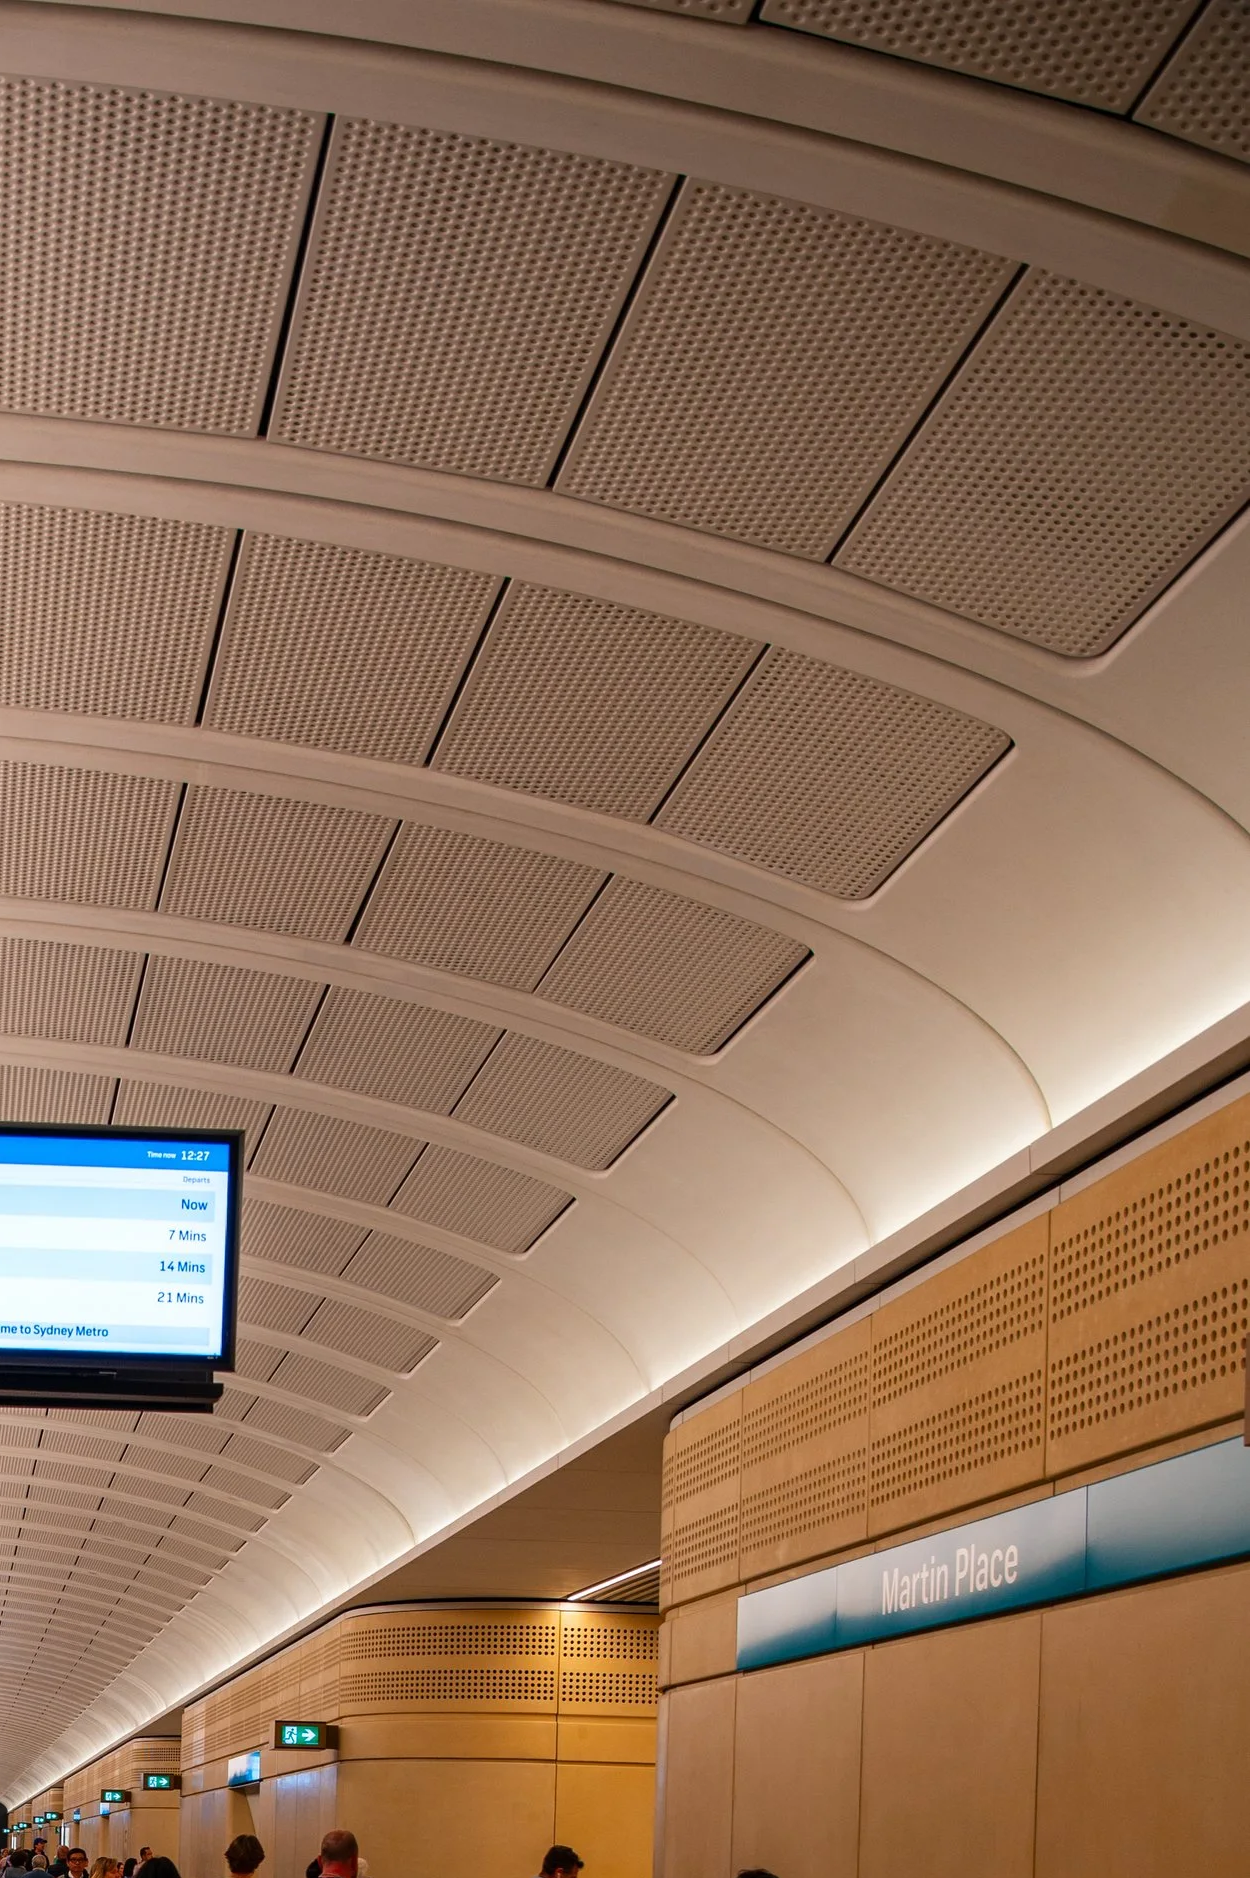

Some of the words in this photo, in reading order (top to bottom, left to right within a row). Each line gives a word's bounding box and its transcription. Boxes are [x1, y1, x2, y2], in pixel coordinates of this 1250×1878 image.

[147, 1150, 162, 1159] Time
[181, 1150, 210, 1161] 12:27
[182, 1175, 211, 1184] Departs
[181, 1198, 208, 1211] Now
[168, 1229, 175, 1241] 7
[178, 1230, 207, 1242] Mins
[159, 1260, 175, 1272] 14
[177, 1261, 206, 1273] Mins
[157, 1291, 173, 1303] 21
[176, 1292, 204, 1304] Mins
[19, 1323, 32, 1335] to
[33, 1324, 74, 1338] Sydney
[75, 1326, 109, 1338] Metro
[881, 1555, 948, 1616] Martin
[954, 1543, 1019, 1597] Place
